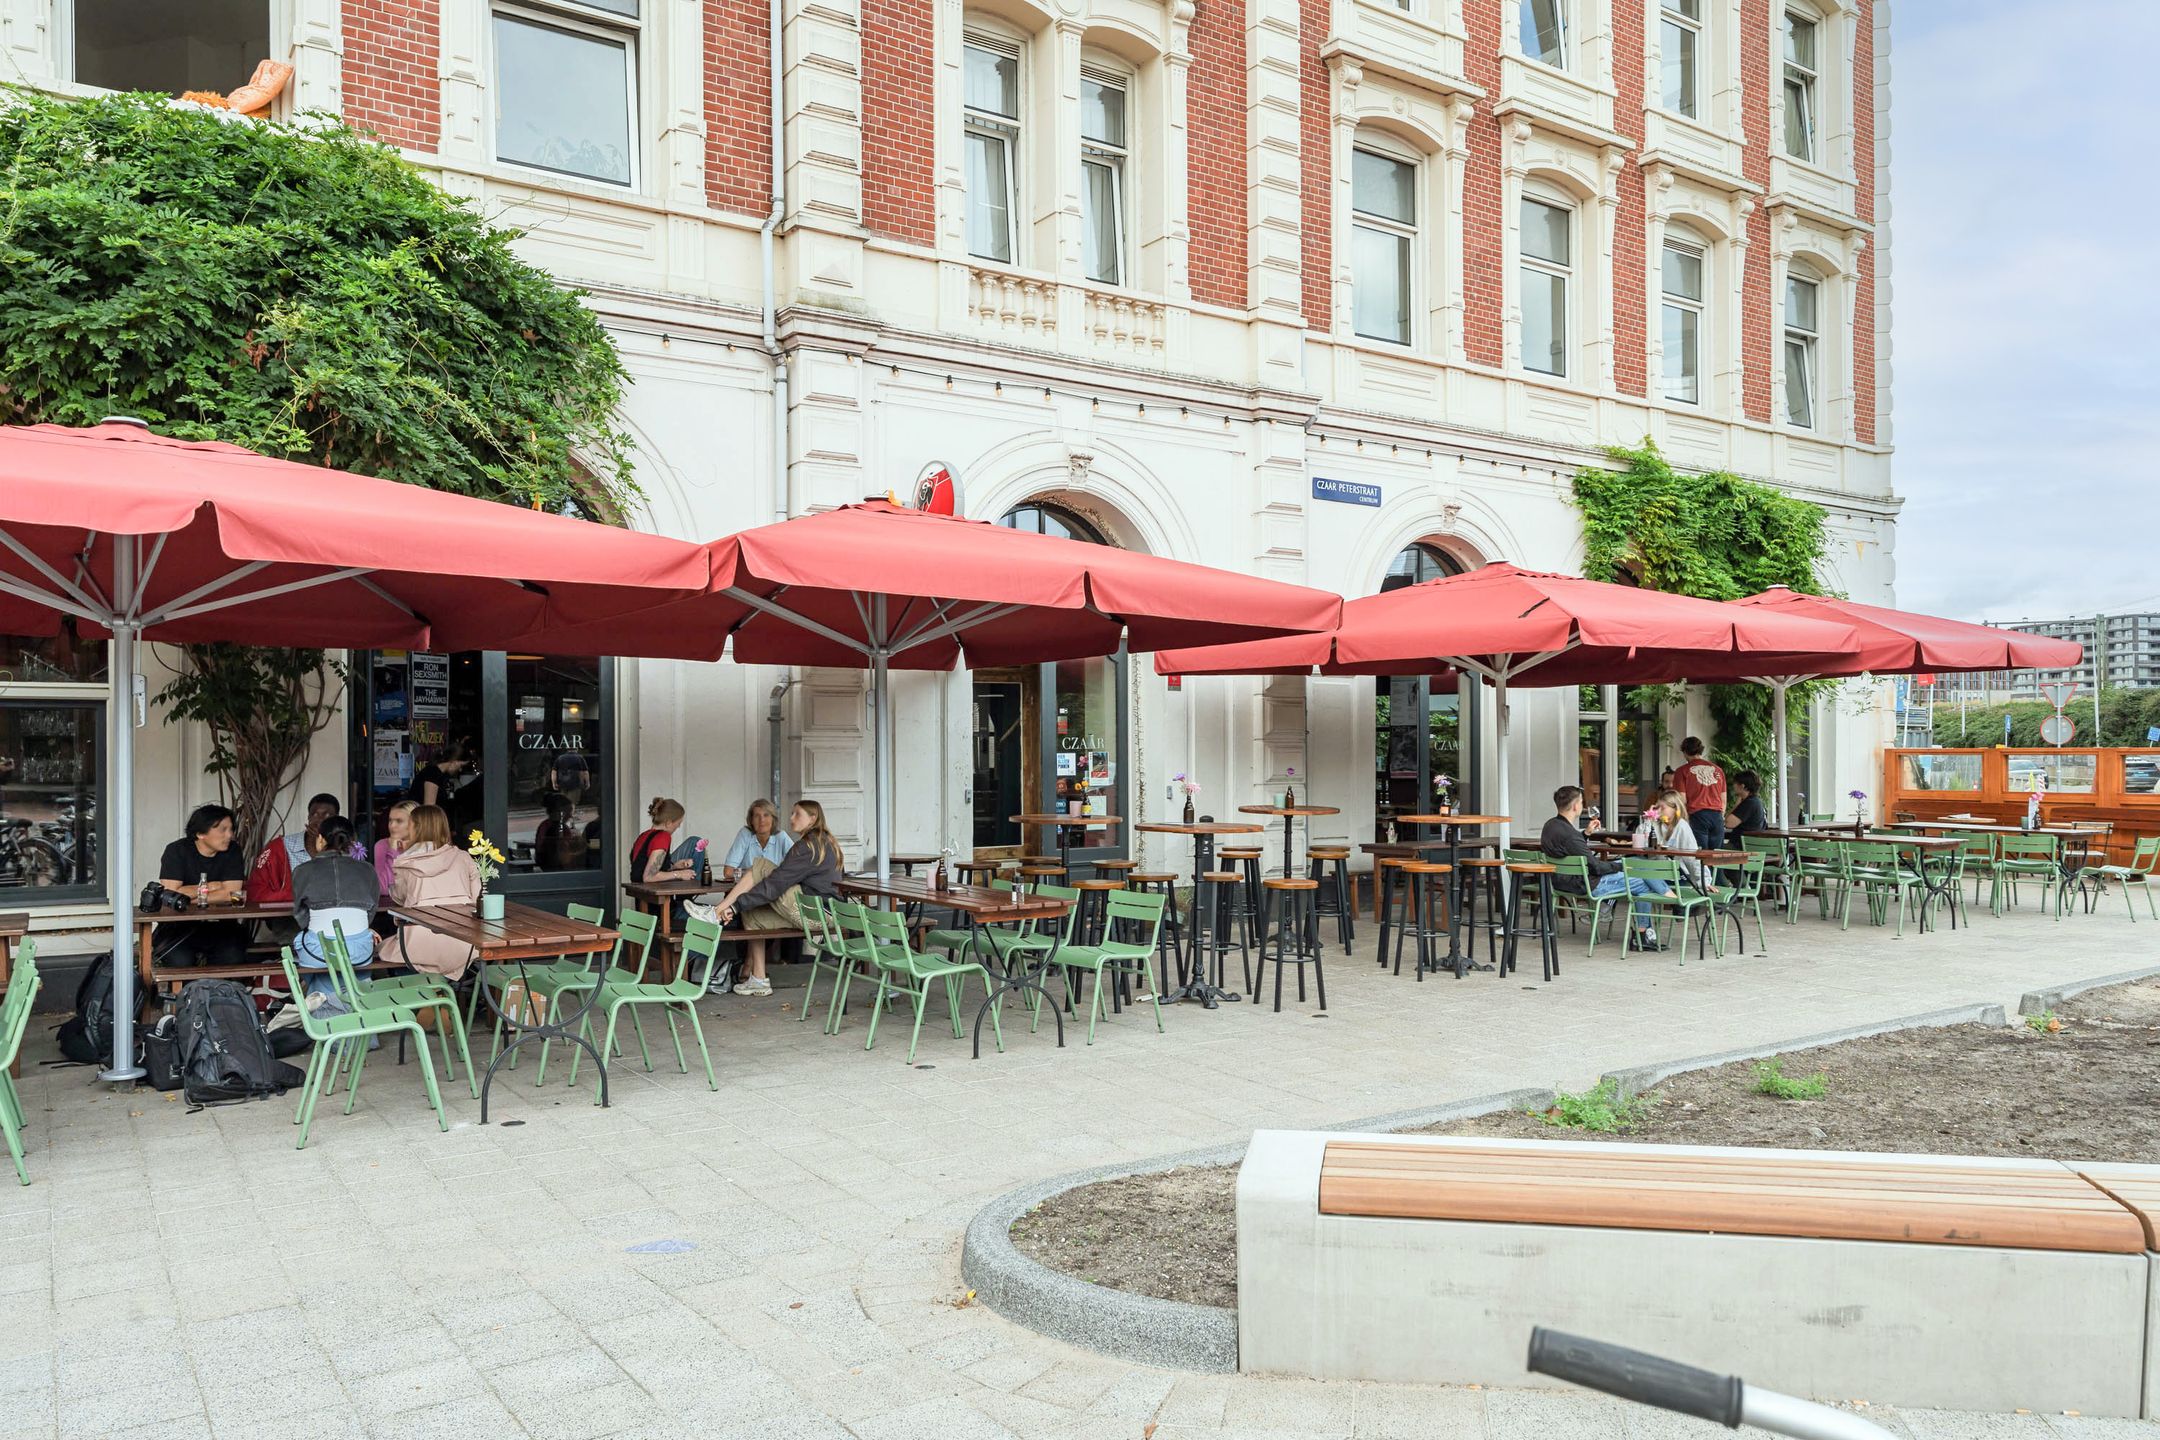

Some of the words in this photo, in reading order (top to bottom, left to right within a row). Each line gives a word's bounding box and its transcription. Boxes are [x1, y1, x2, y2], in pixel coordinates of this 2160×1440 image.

[1316, 480, 1337, 491] CZAAR
[1338, 483, 1378, 496] PETERSTRAAT
[423, 663, 439, 671] RON
[414, 670, 447, 680] SEXSMITH
[414, 695, 447, 704] JAYHAWKS
[519, 734, 584, 749] CZAAR
[1062, 737, 1105, 749] CZAAR
